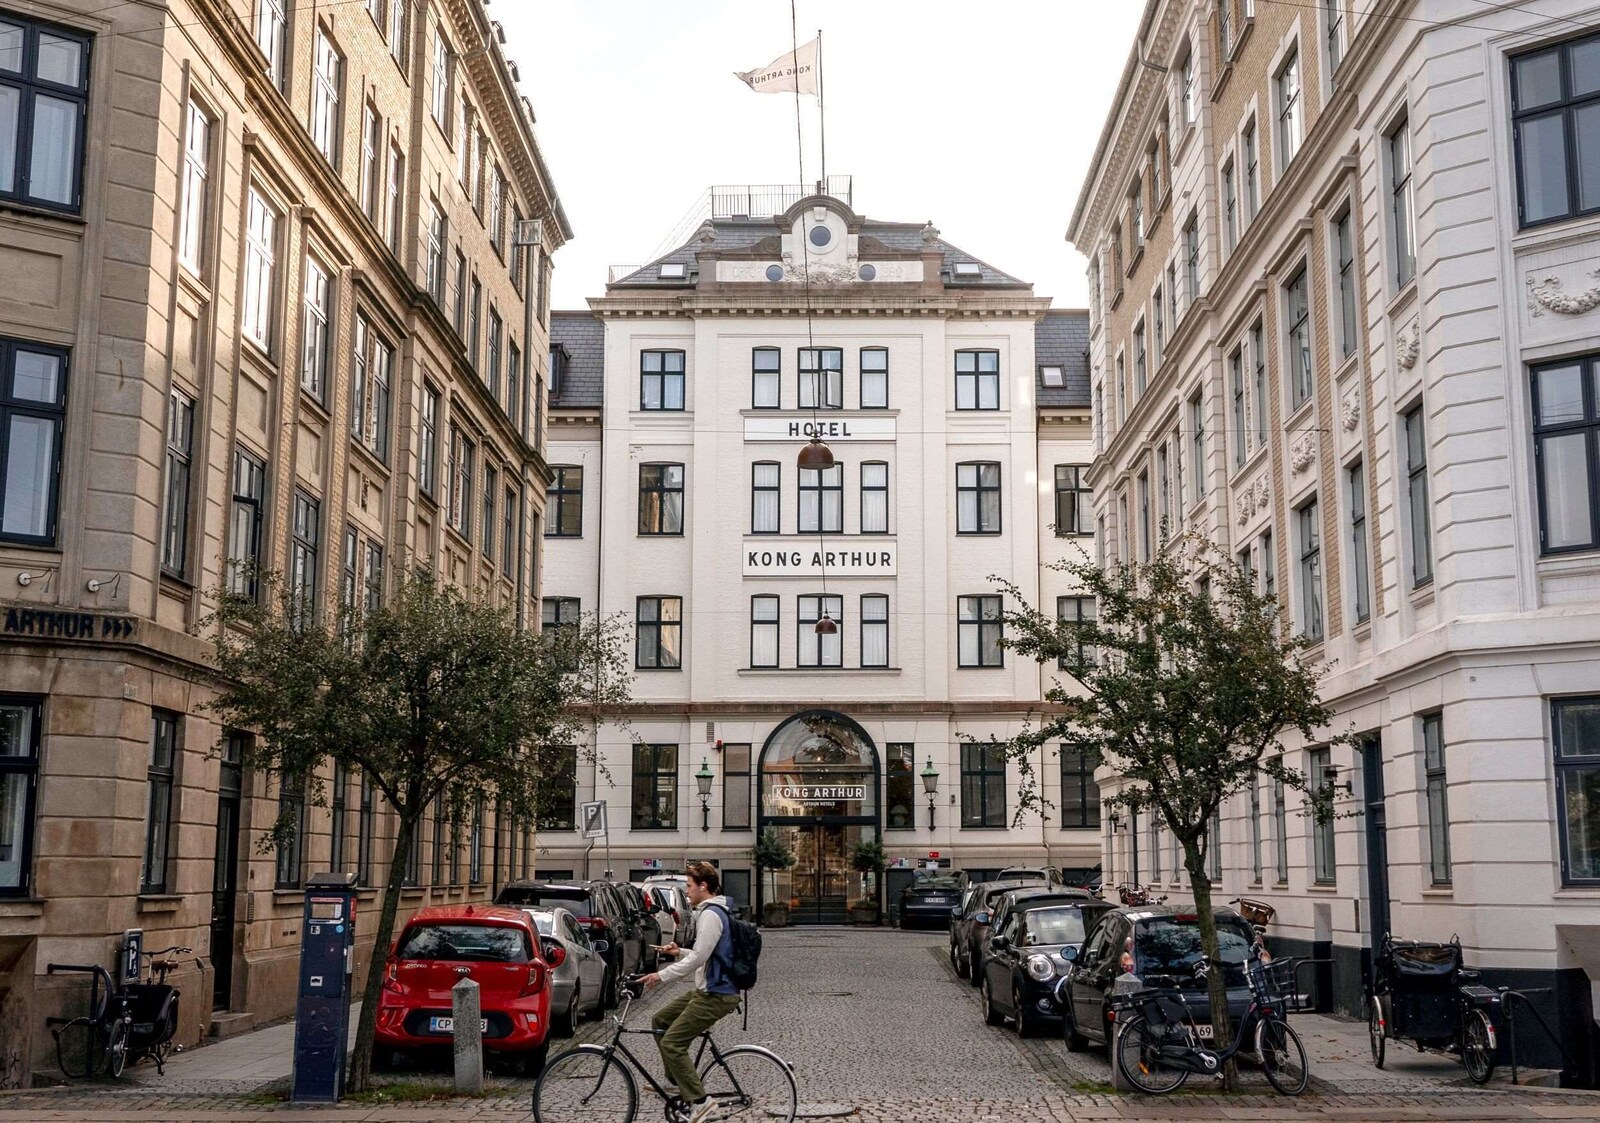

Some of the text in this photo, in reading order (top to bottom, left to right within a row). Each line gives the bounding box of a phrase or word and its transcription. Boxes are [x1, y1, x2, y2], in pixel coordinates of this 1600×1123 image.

[788, 422, 852, 437] HOTEL
[748, 551, 891, 567] KONG ARTHUR
[4, 608, 94, 638] ARTHUR
[776, 788, 863, 798] KONG ARTHUR
[588, 806, 597, 820] P
[438, 1019, 451, 1029] CP
[1199, 1026, 1211, 1036] 69
